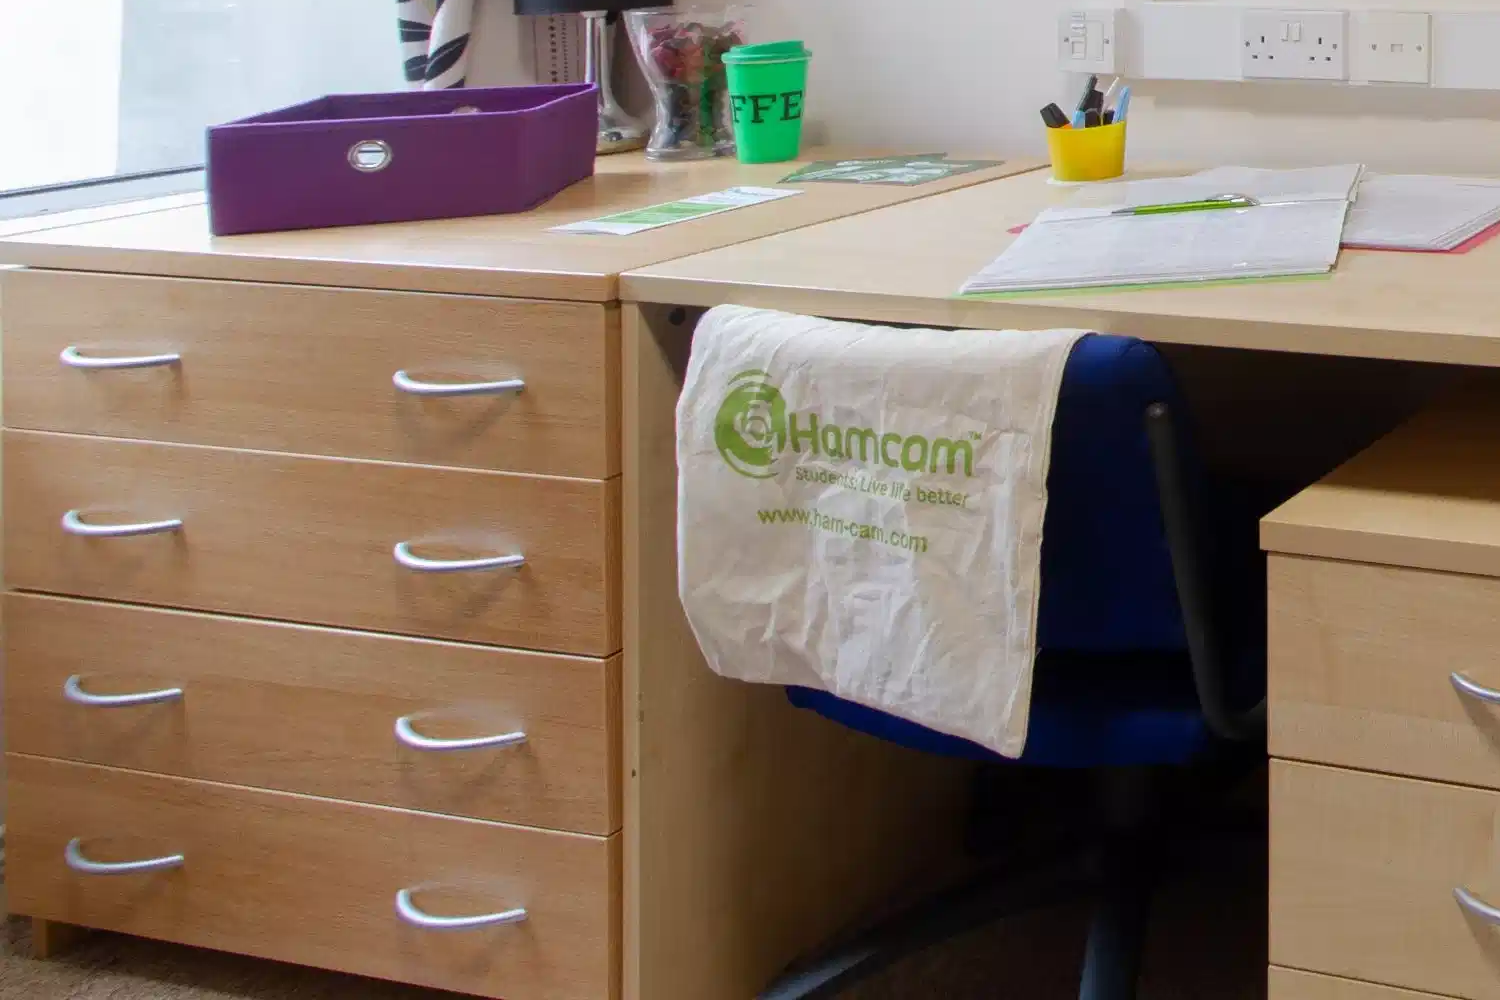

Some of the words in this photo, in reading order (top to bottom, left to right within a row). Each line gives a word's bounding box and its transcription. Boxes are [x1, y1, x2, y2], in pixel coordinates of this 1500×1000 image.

[788, 412, 974, 477] Hamcam
[859, 474, 889, 496] Live
[916, 485, 969, 508] better
[756, 506, 929, 554] www.ham-cam.com
